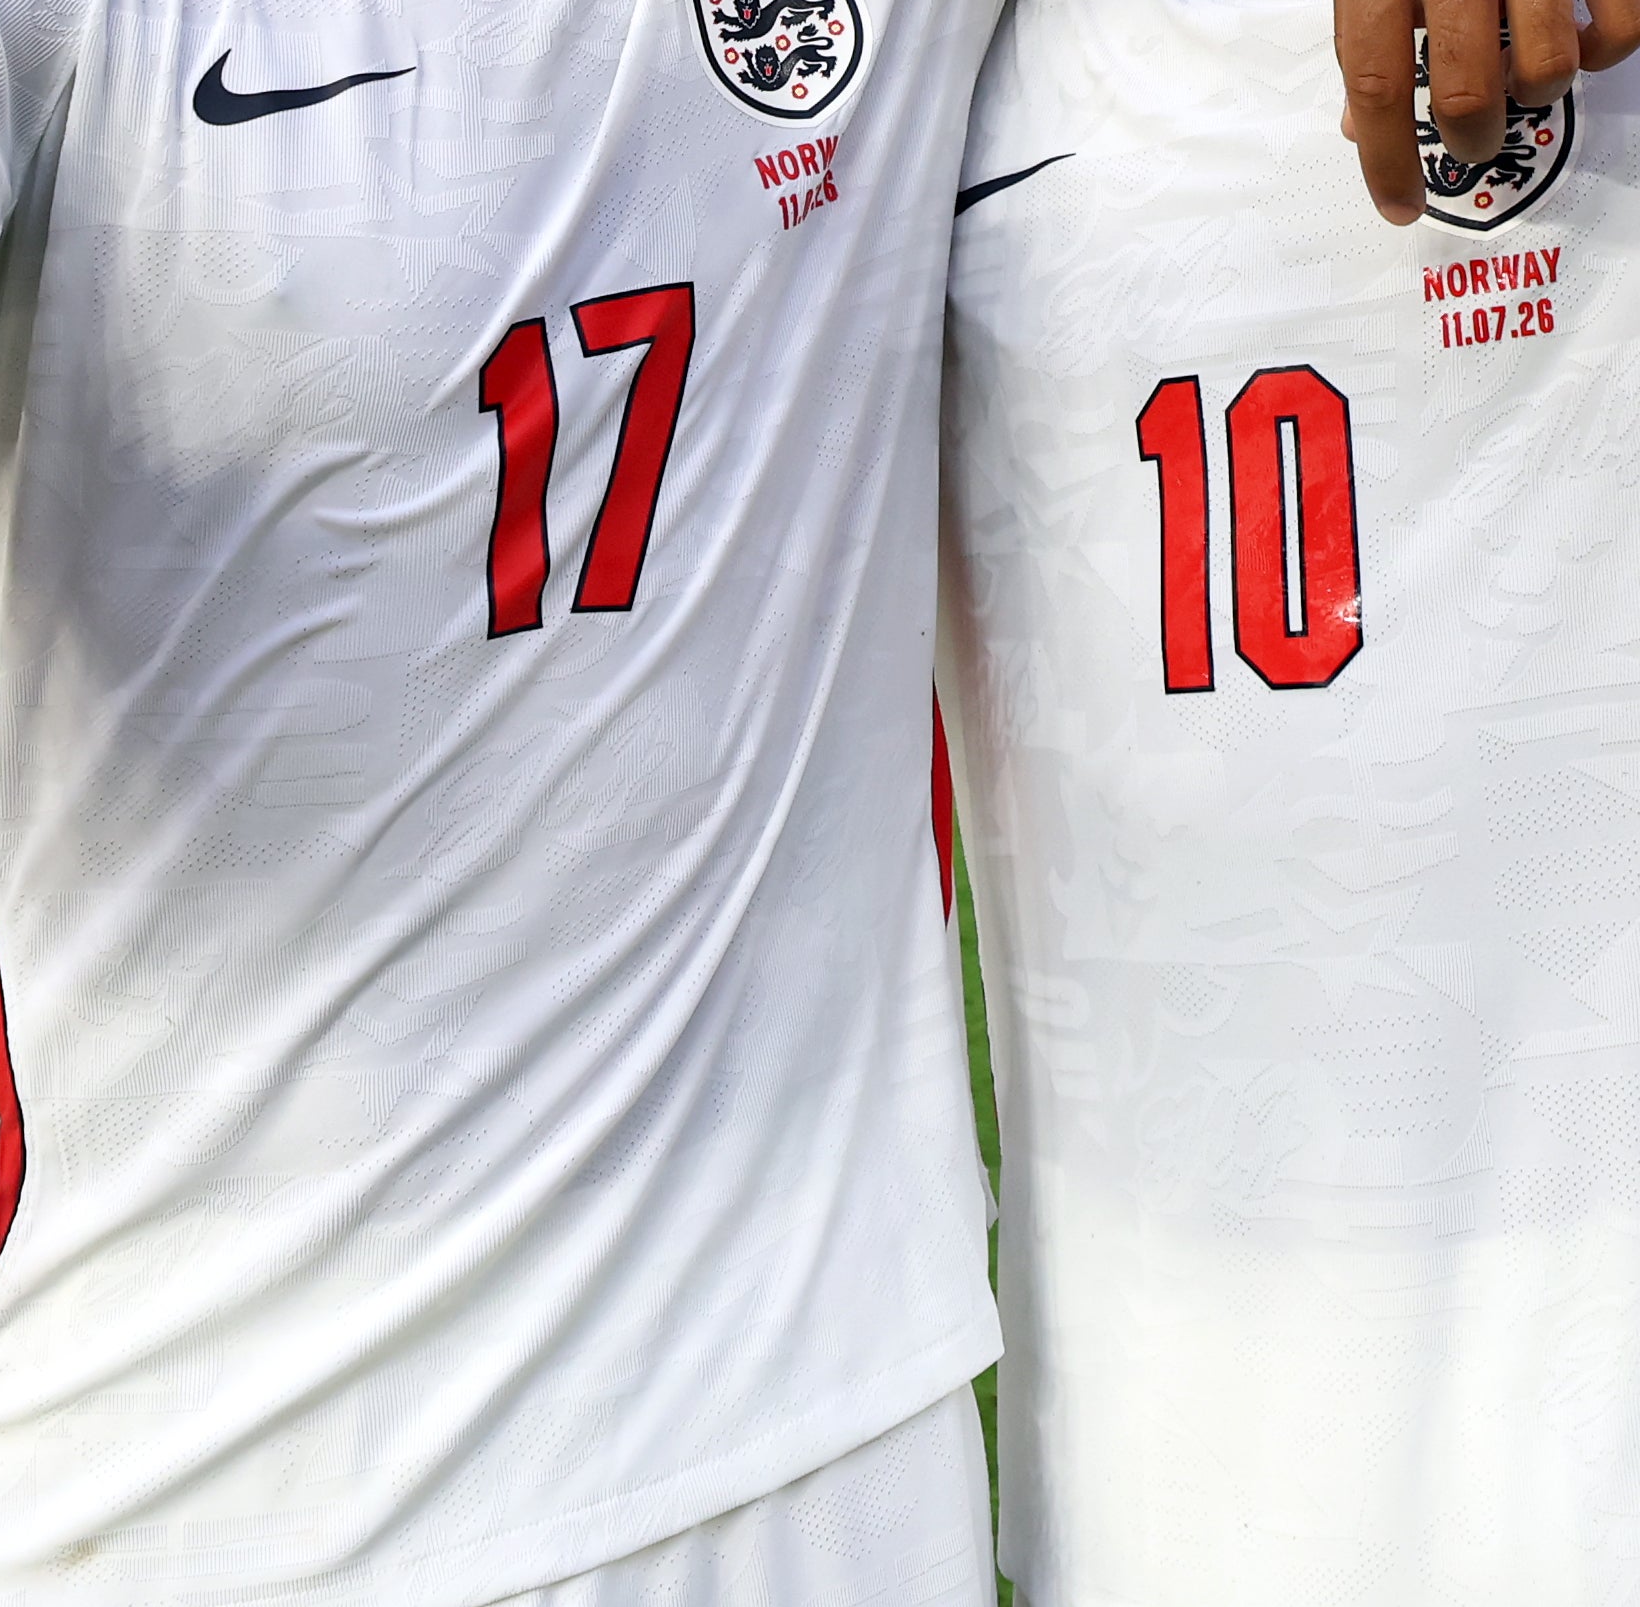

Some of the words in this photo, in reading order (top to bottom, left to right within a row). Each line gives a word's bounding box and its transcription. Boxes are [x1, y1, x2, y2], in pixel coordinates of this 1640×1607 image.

[1423, 247, 1561, 301] NORWAY
[1439, 298, 1554, 348] 11.07.26
[479, 281, 695, 639] 17
[1136, 364, 1364, 694] 10
